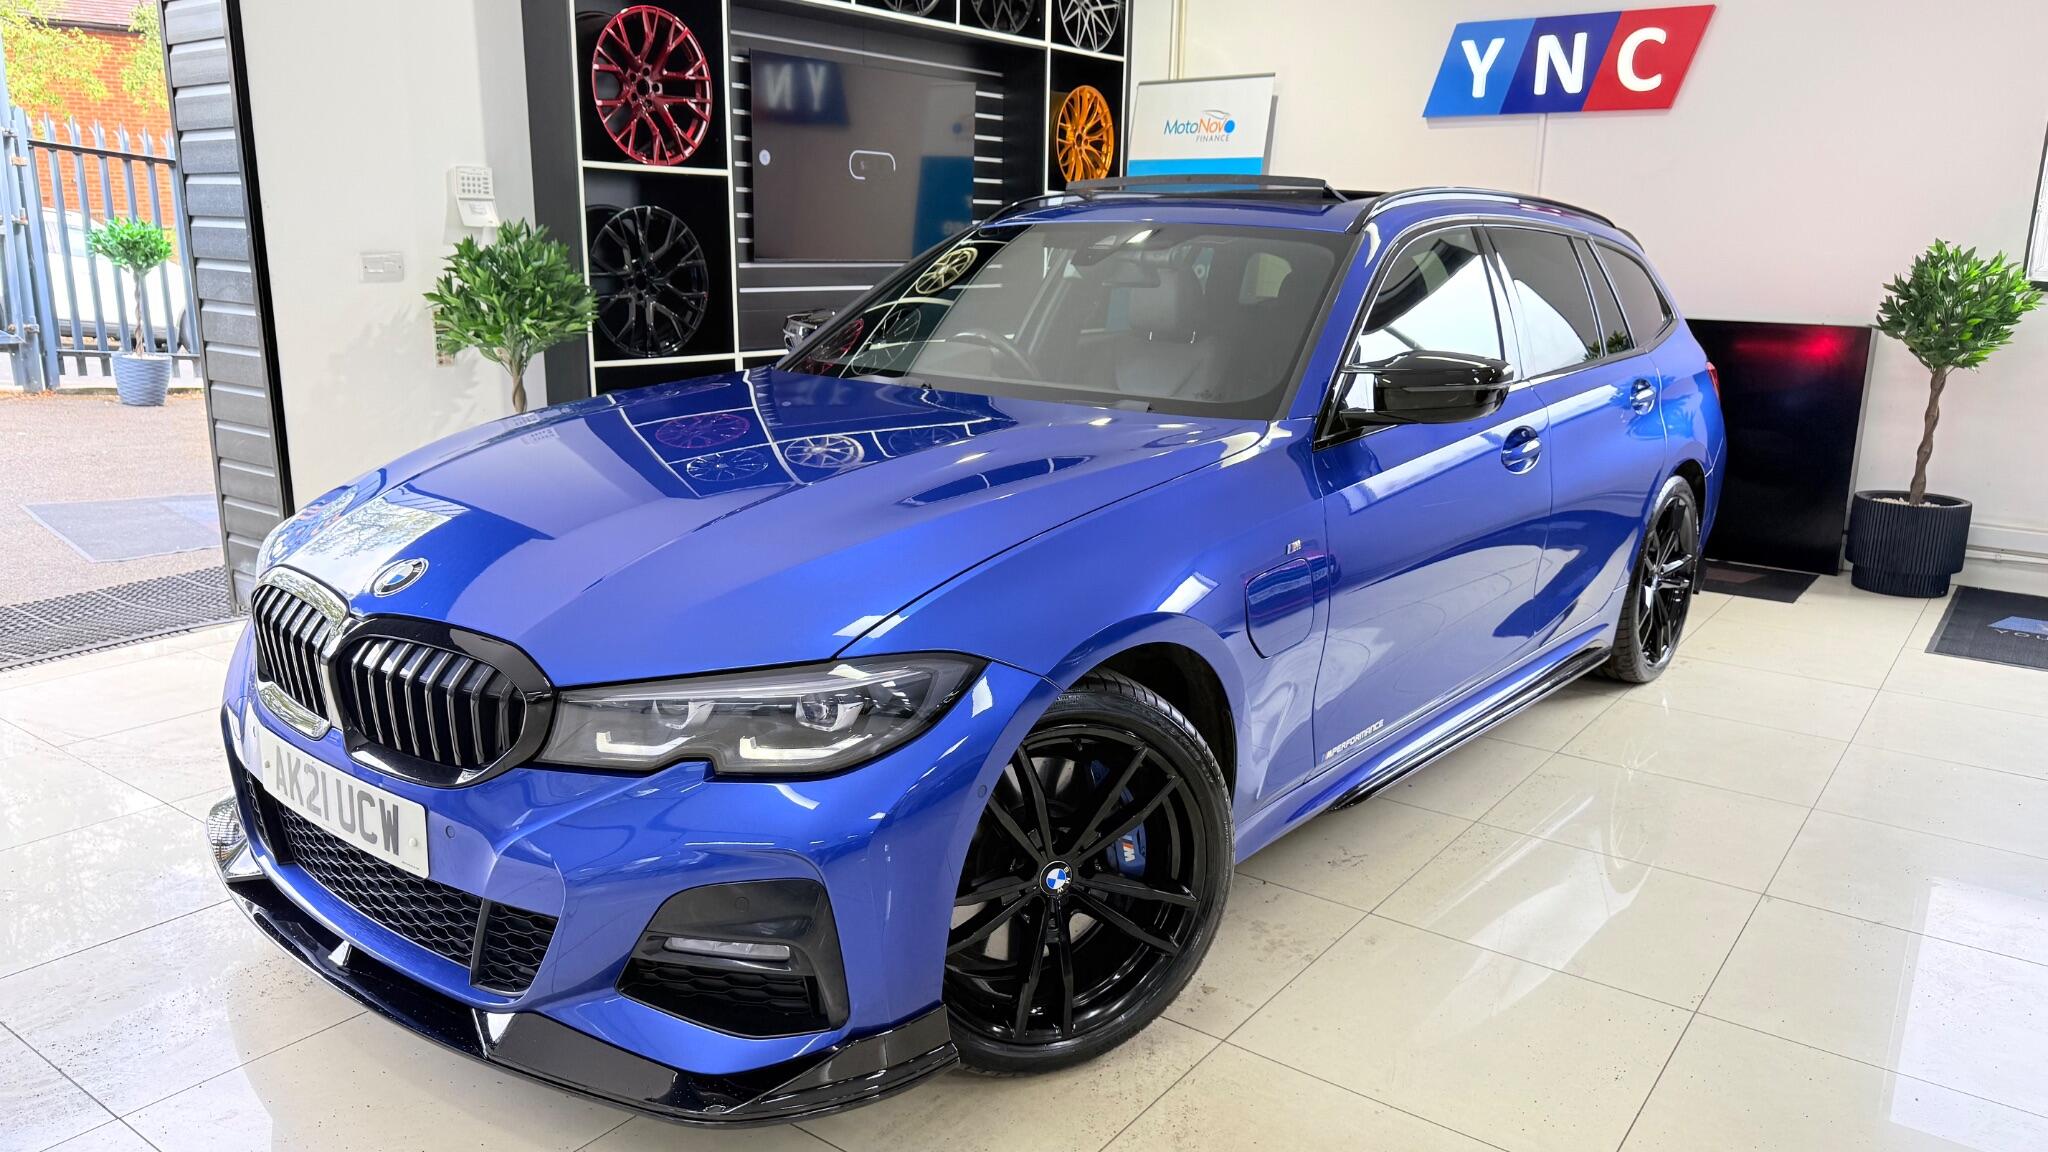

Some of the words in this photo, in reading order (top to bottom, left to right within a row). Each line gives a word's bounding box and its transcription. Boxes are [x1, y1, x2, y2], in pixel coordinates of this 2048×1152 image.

[1461, 26, 1667, 99] YNC
[1163, 118, 1236, 135] MotoNovo
[1195, 134, 1230, 142] FINANCE
[1332, 719, 1385, 755] PERFORMANCE
[275, 744, 331, 822] AK21
[335, 777, 400, 856] UCW
